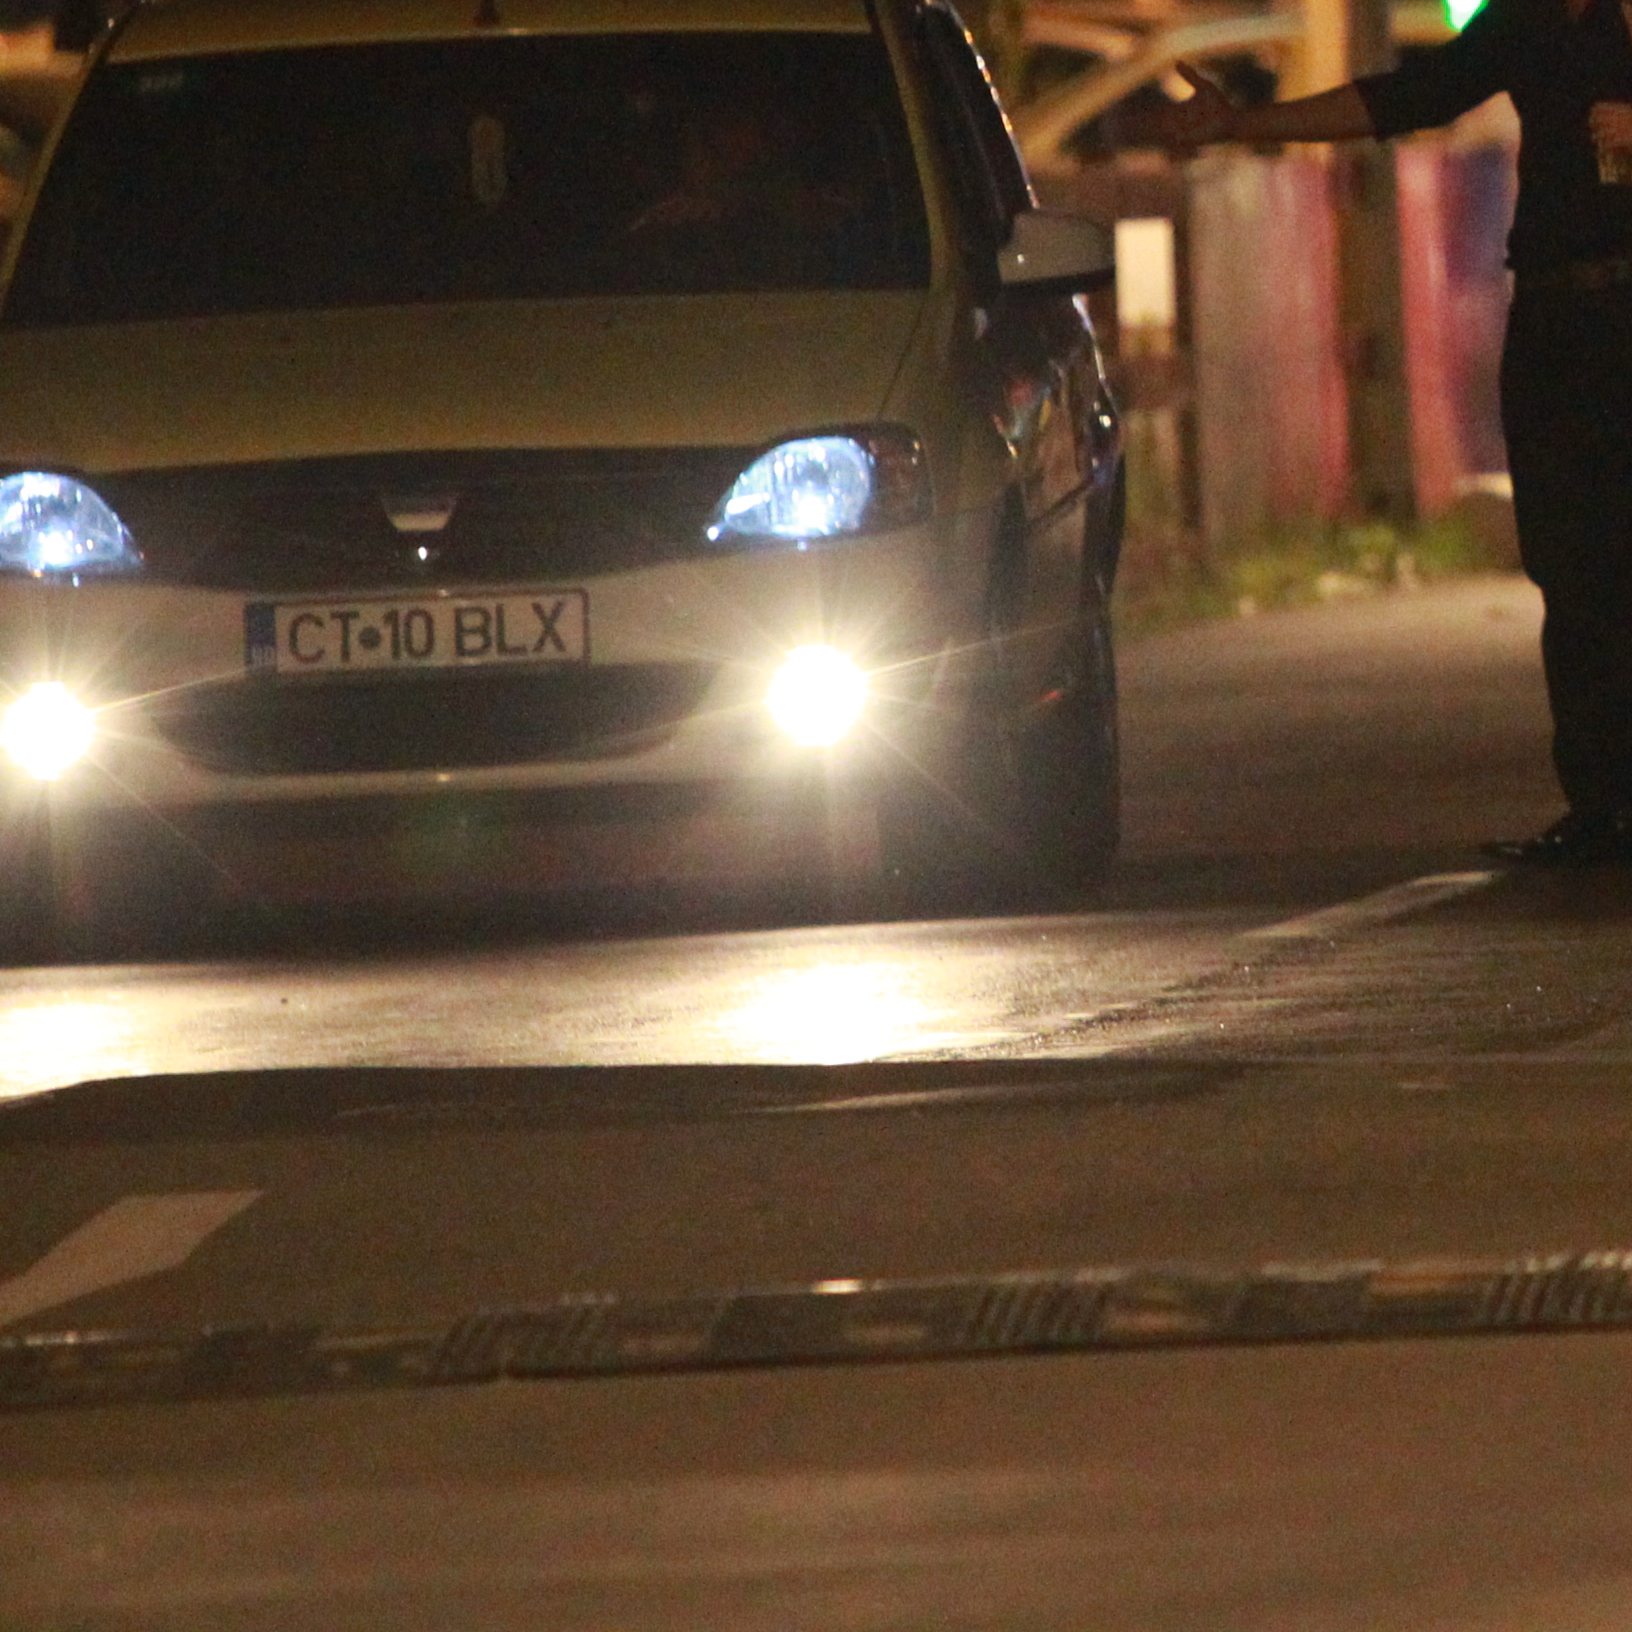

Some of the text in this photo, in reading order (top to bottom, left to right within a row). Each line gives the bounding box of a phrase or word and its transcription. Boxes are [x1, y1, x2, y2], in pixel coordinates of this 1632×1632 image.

[289, 600, 566, 663] CT 10 BLX
